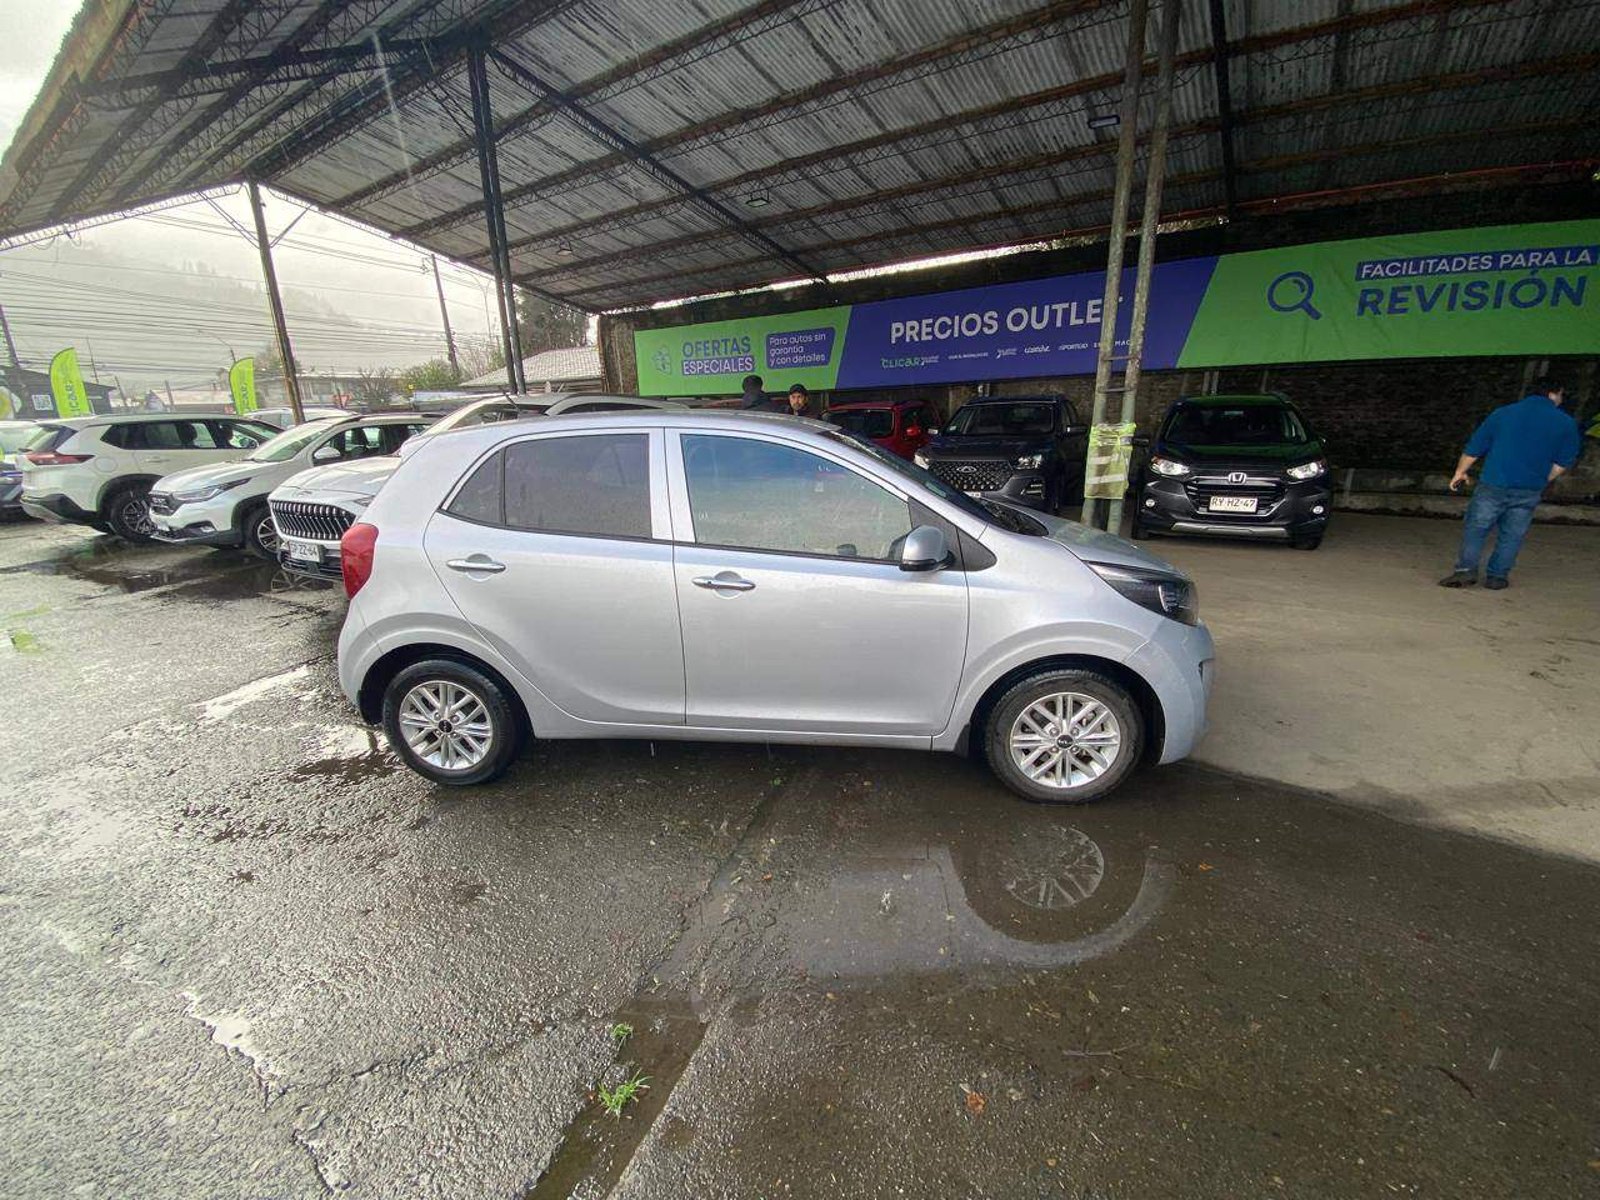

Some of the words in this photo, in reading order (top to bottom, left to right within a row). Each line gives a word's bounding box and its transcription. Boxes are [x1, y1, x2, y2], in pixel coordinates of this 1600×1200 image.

[1361, 255, 1493, 278] FACILITADES
[1498, 250, 1557, 268] PARA
[1564, 249, 1591, 264] LA
[1356, 269, 1588, 316] REVISIÓN
[890, 310, 999, 344] PRECIOS
[1006, 296, 1123, 332] OUTLE
[682, 336, 751, 357] OFERTAS
[770, 336, 788, 346] Para
[789, 335, 813, 344] autos
[815, 333, 826, 342] sin
[683, 357, 754, 374] ESPECIALES
[776, 356, 791, 365] con
